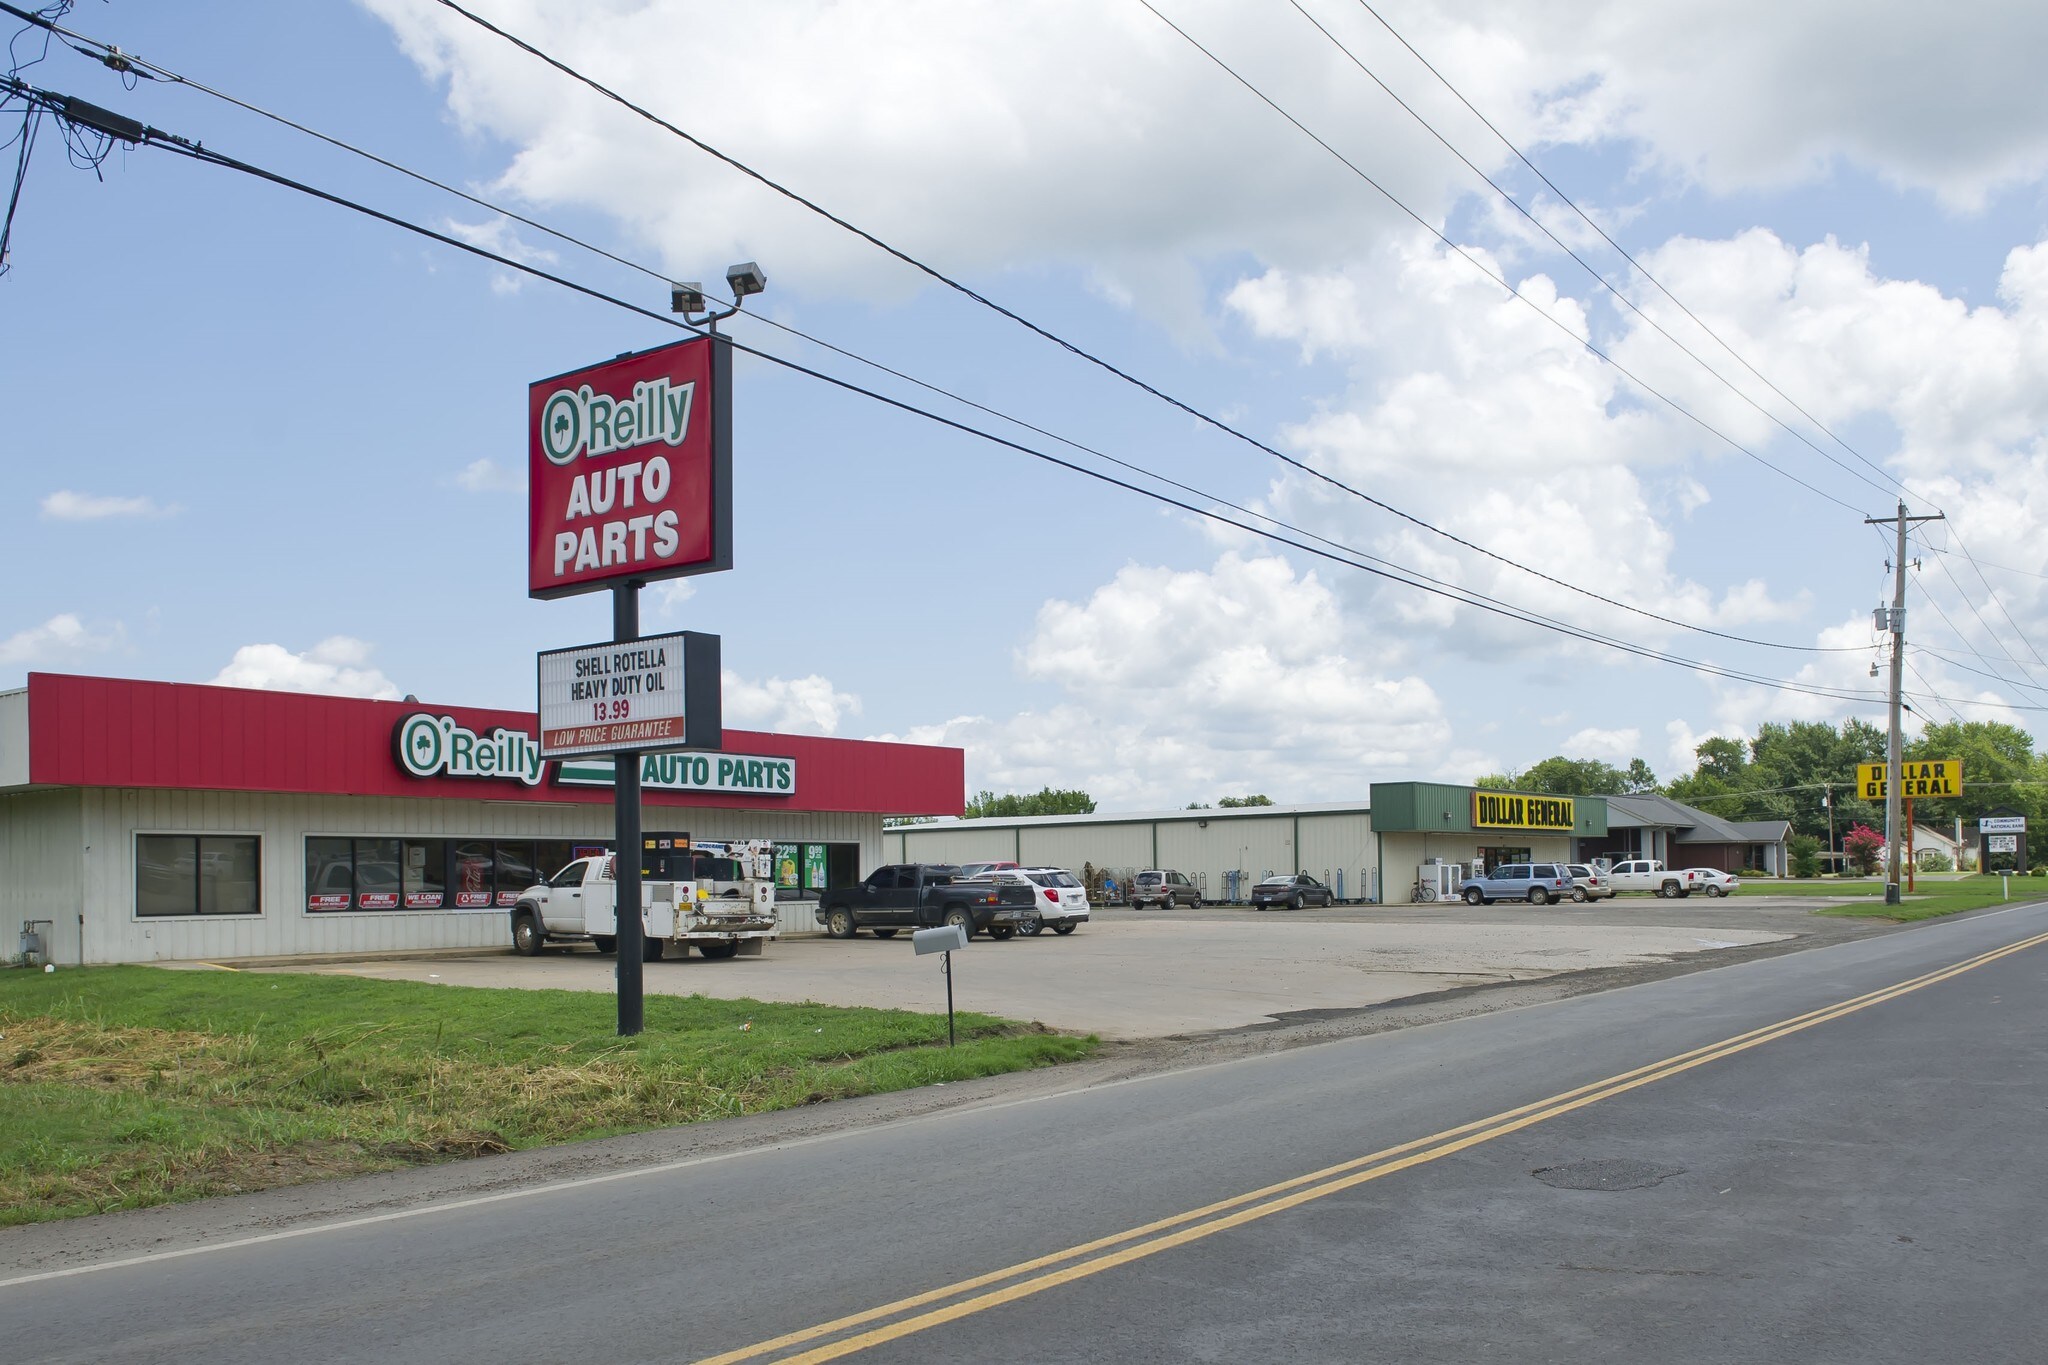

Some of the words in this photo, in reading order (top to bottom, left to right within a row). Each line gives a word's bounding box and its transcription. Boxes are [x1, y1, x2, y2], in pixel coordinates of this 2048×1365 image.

[543, 381, 691, 461] O'Reilly
[565, 456, 671, 520] AUTO
[554, 509, 679, 577] PARTS
[575, 654, 611, 678] SHELL
[613, 648, 666, 673] ROTELLA
[571, 678, 608, 701] HEAVY
[612, 674, 642, 697] DUTY
[646, 671, 665, 692] OIL
[593, 699, 630, 721] 13.99
[553, 730, 576, 747] LOW
[578, 726, 607, 744] PRICE
[611, 720, 673, 741] GUARANTEE
[405, 719, 541, 780] O'Reilly
[641, 755, 710, 786] AUTO
[717, 757, 791, 790] PARTS
[1871, 763, 1945, 781] DLLAR
[1866, 779, 1952, 797] GEERAL
[1478, 795, 1524, 825] DOLLAR
[1527, 798, 1573, 827] GENERAL
